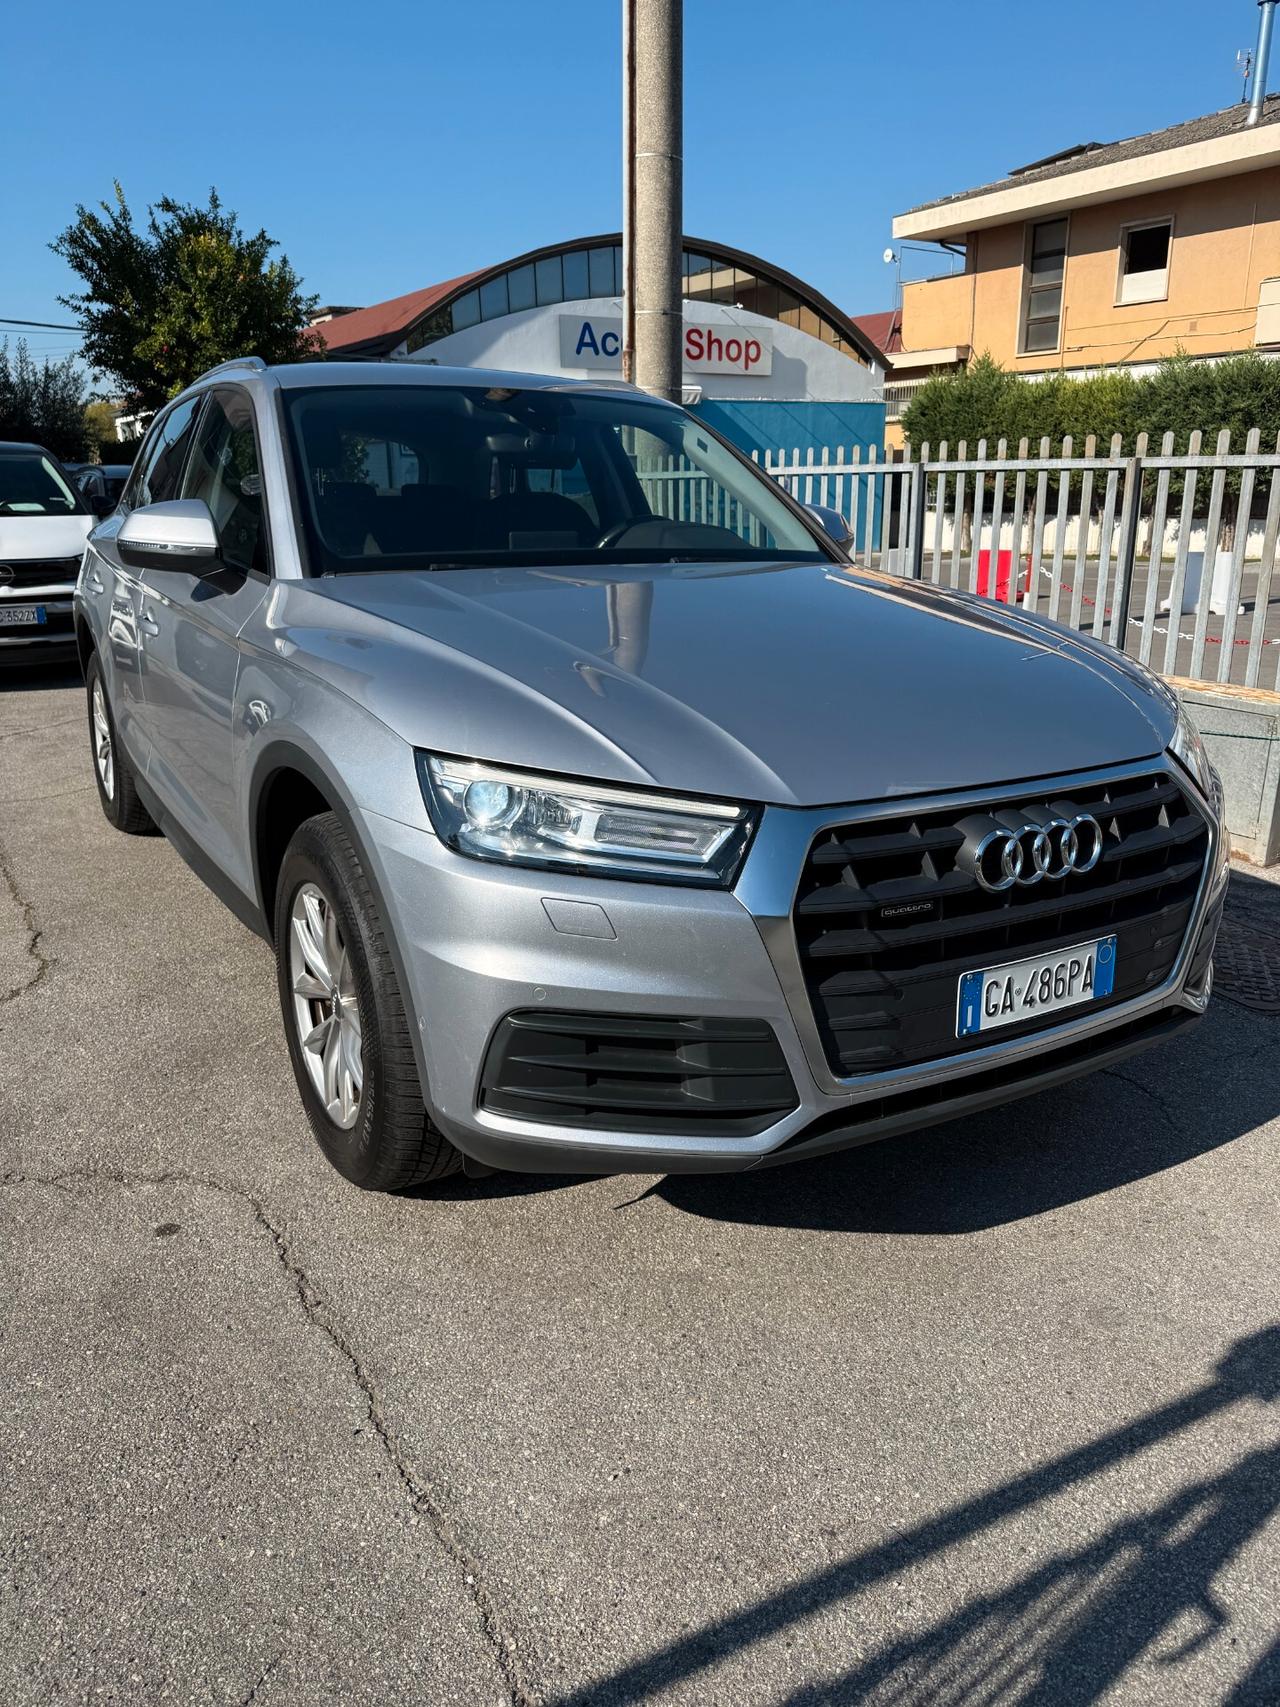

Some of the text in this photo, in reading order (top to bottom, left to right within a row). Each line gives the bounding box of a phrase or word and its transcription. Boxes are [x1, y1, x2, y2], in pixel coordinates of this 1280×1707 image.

[575, 321, 761, 371] Ac Shop
[884, 903, 931, 916] quattro
